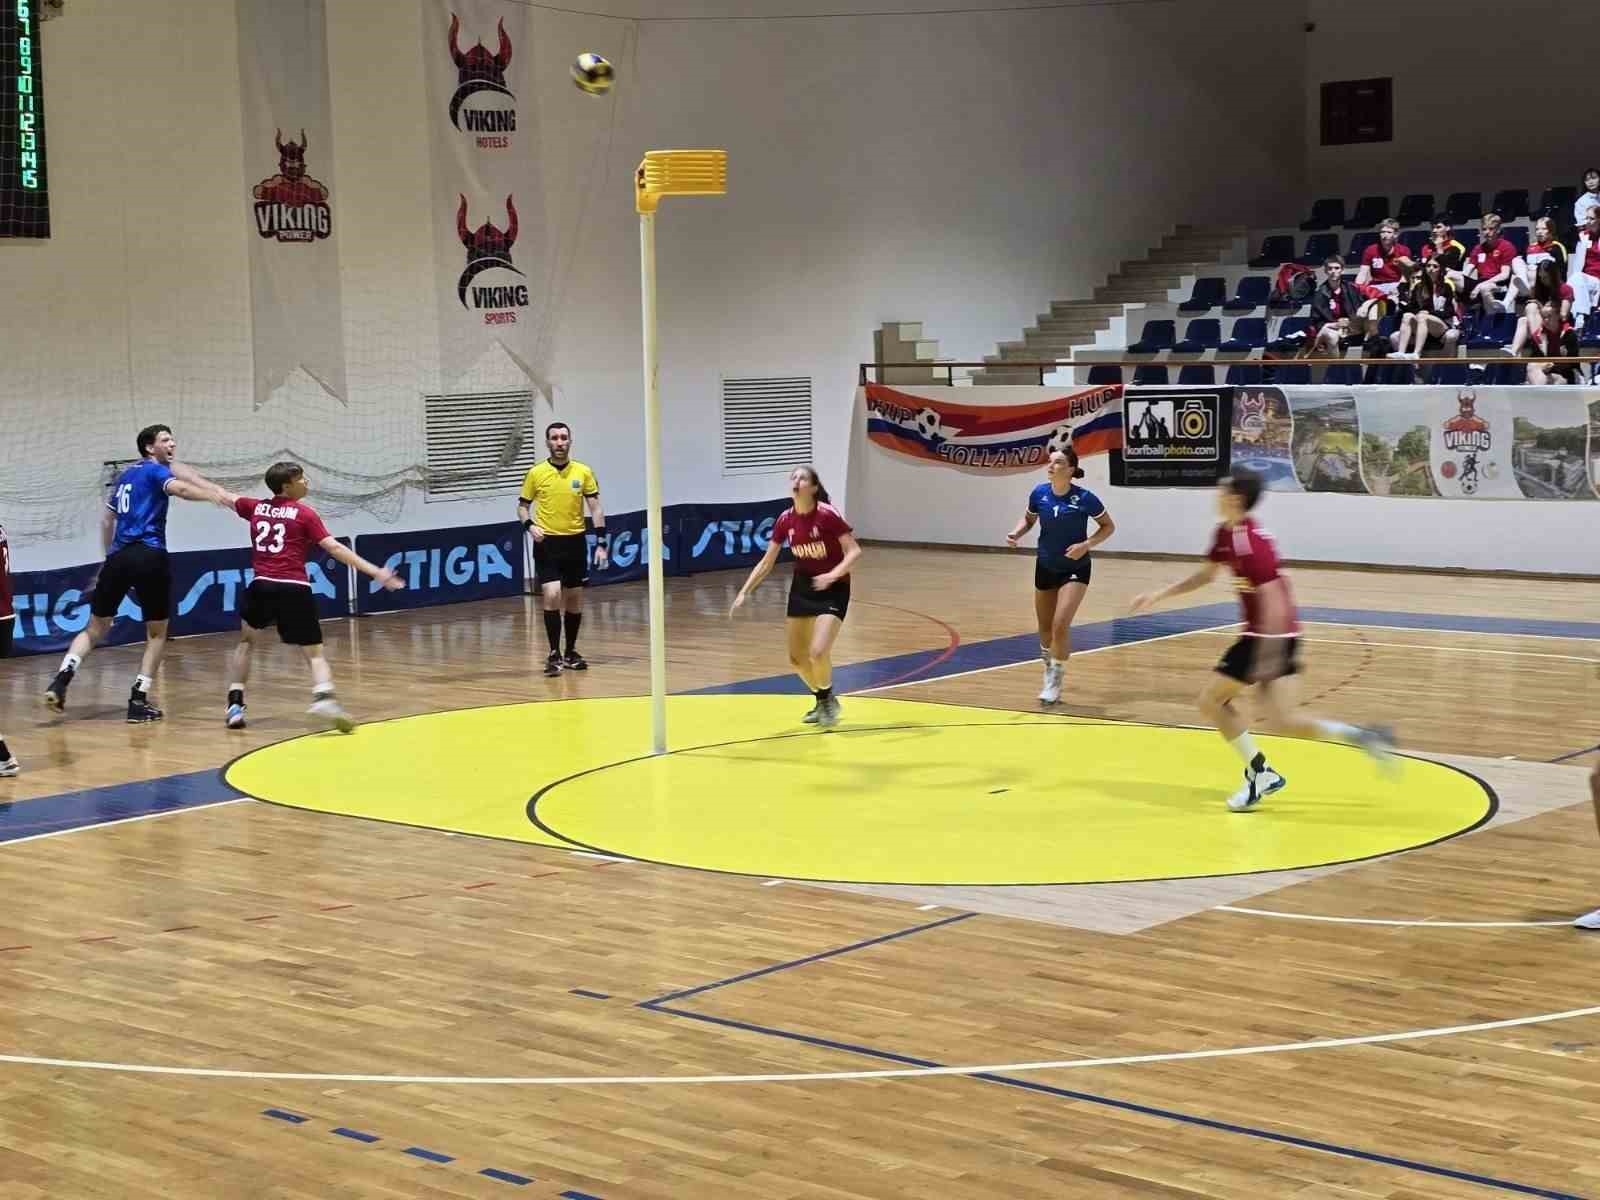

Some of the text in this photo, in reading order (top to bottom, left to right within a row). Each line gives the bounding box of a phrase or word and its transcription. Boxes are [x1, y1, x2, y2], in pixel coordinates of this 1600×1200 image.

[463, 109, 516, 132] VIKING
[475, 136, 508, 148] HOTELS
[257, 204, 329, 233] VIKING
[471, 285, 529, 309] VIKING
[484, 312, 517, 324] SPORTS
[1127, 444, 1215, 458] korfballphoto.com
[1446, 432, 1490, 449] VIKING
[936, 443, 1044, 468] HOLLAND
[115, 483, 133, 514] 16
[254, 503, 298, 520] BELGIUM
[255, 521, 286, 553] 23
[692, 517, 789, 558] STIG
[369, 543, 513, 595] STIGA
